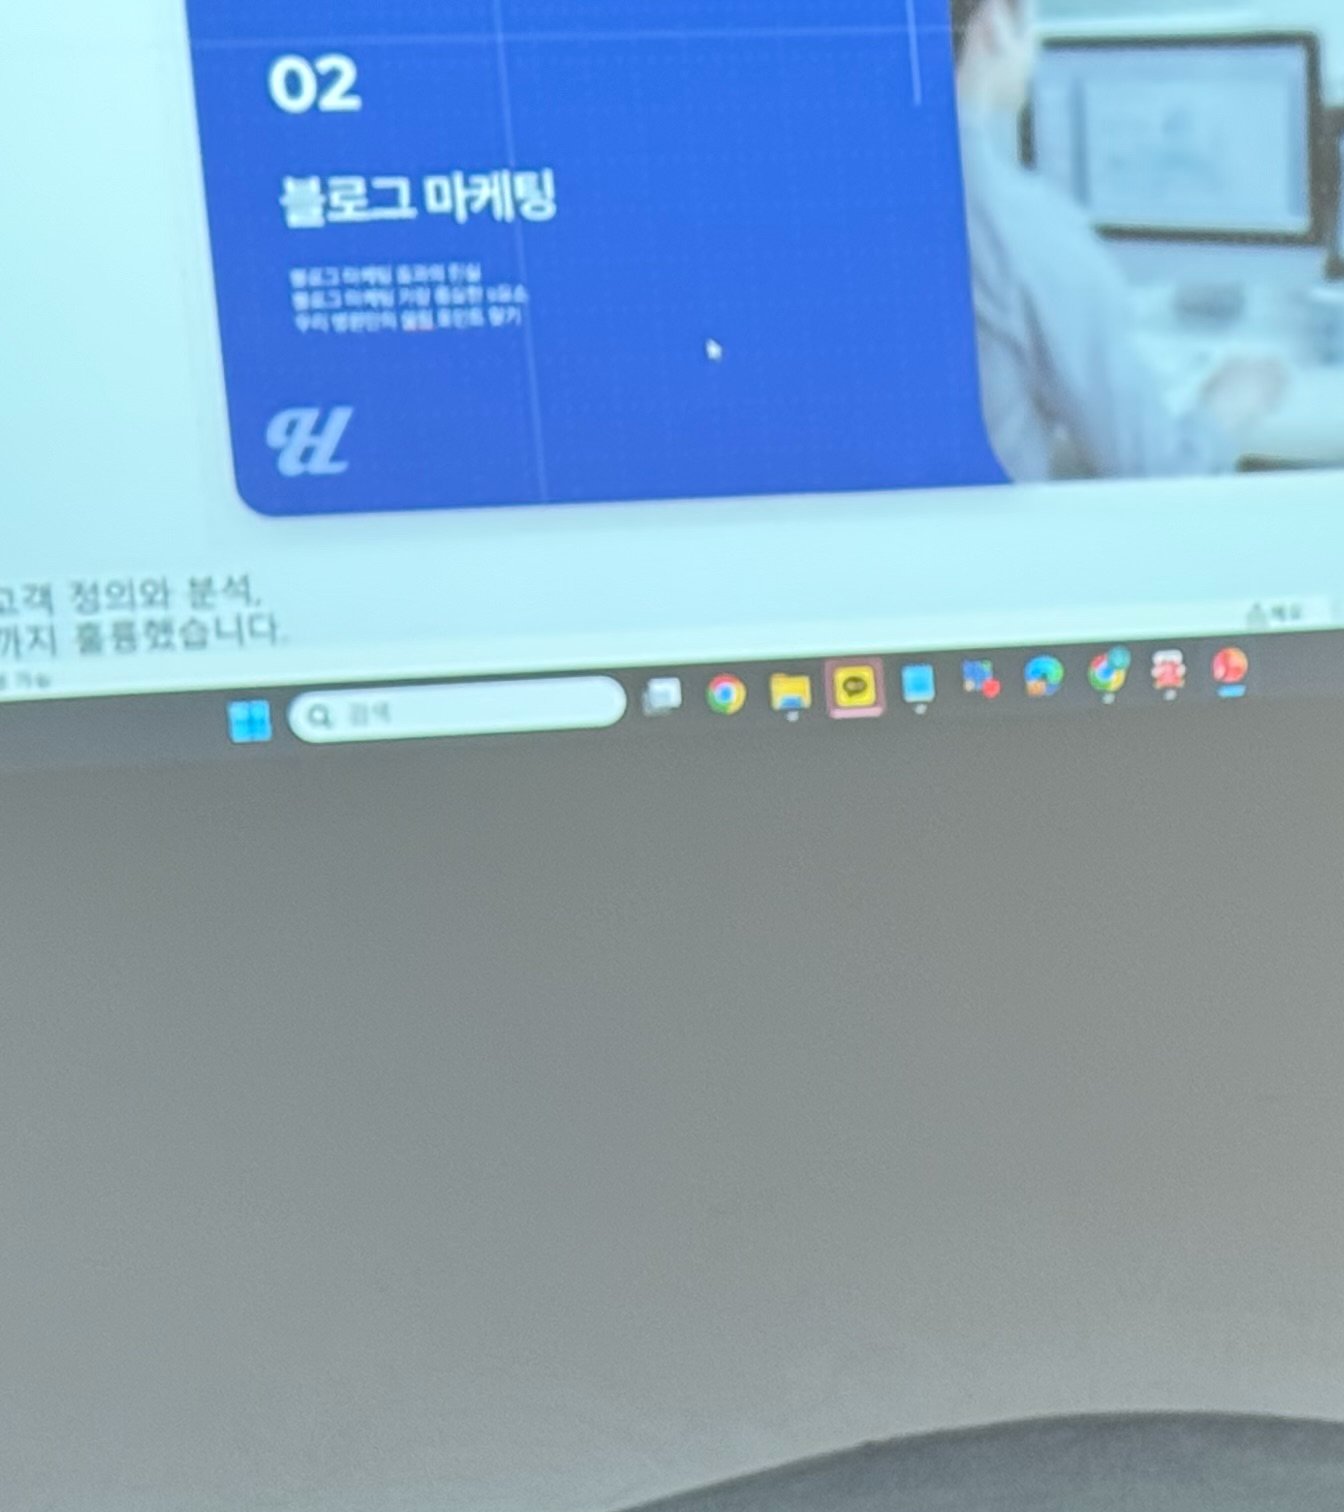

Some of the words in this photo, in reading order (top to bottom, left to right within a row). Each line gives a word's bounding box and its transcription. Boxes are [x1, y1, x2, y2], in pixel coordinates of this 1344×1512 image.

[268, 54, 362, 113] 02
[280, 174, 418, 229] 블로그
[423, 167, 557, 224] 마케팅
